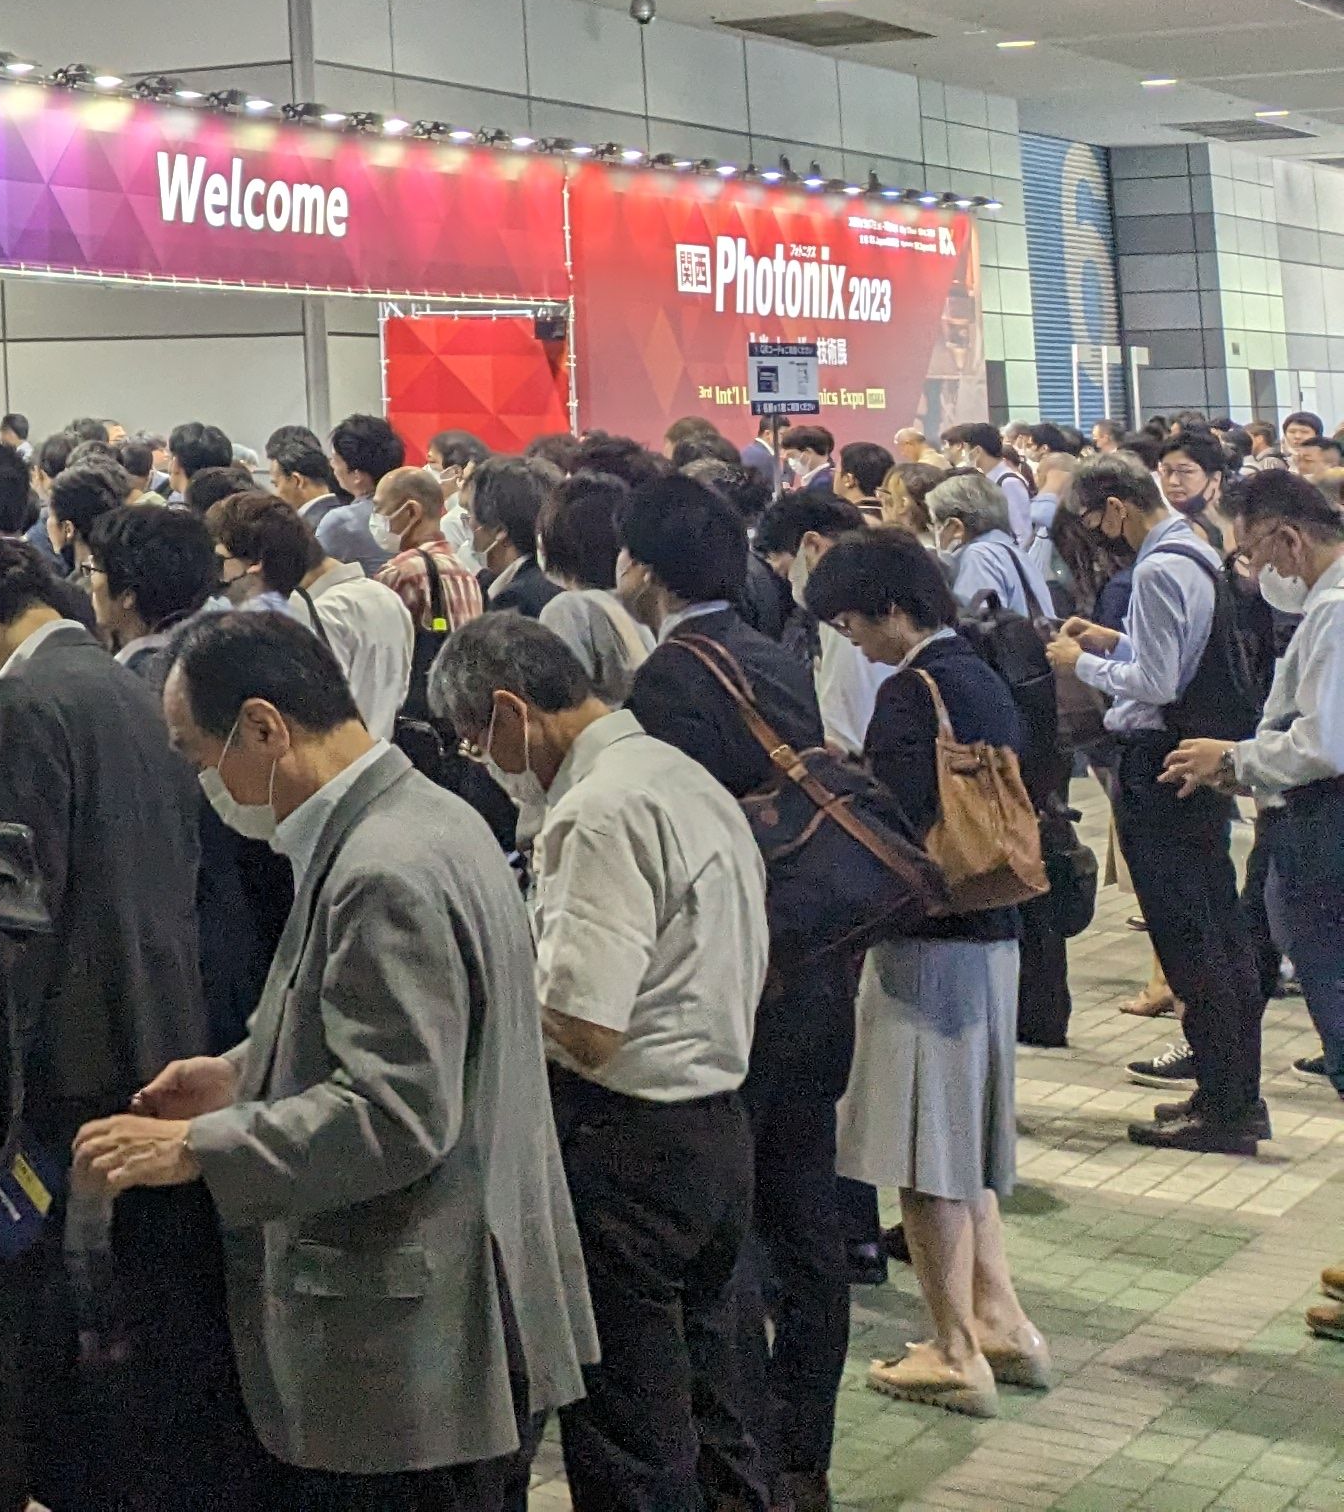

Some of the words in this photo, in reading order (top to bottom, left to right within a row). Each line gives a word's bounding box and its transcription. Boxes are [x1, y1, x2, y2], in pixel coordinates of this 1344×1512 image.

[157, 151, 350, 238] Welcome
[715, 235, 847, 320] Photonix
[848, 276, 892, 322] 2023
[840, 388, 865, 410] Expo
